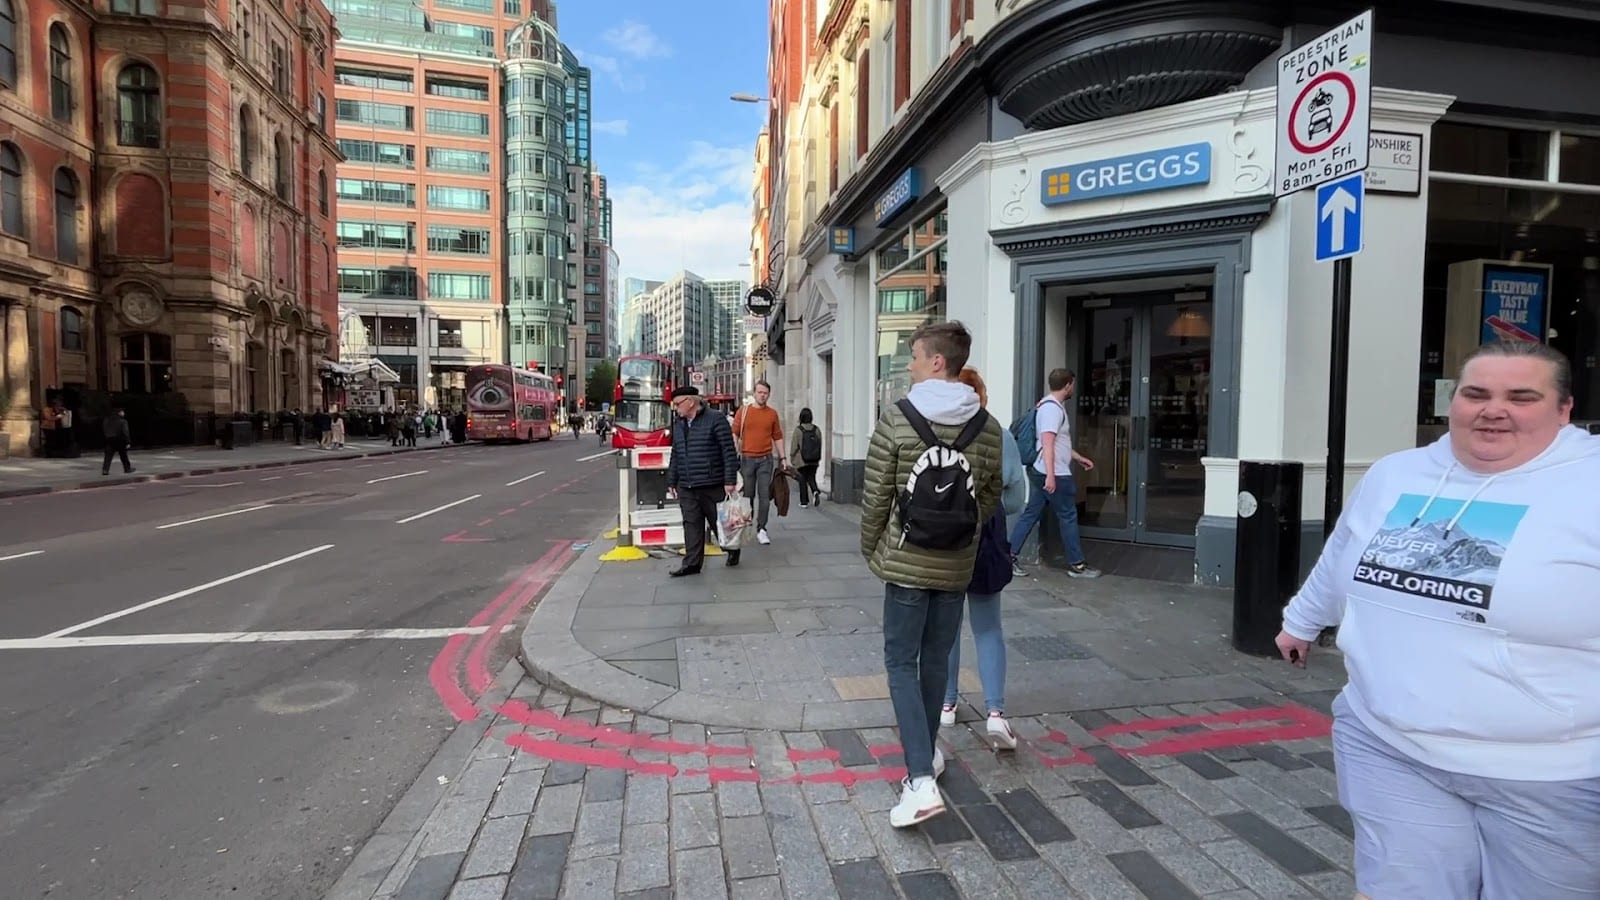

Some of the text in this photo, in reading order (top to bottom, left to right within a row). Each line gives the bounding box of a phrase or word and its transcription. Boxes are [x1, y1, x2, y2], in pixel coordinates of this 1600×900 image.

[1283, 19, 1364, 72] PEDESTRIAN
[1296, 44, 1348, 84] ZONE
[1369, 138, 1412, 151] ONSHIRE
[1393, 153, 1412, 165] EC2
[1076, 151, 1200, 191] GREGGS
[880, 176, 909, 215] GREGGS
[1491, 280, 1539, 295] EVERYDAY
[1500, 295, 1529, 309] TASTY
[1499, 309, 1528, 323] VALUE
[1371, 534, 1437, 555] NEVER
[1362, 549, 1416, 568] STOP
[1355, 565, 1484, 605] EXPLORING
